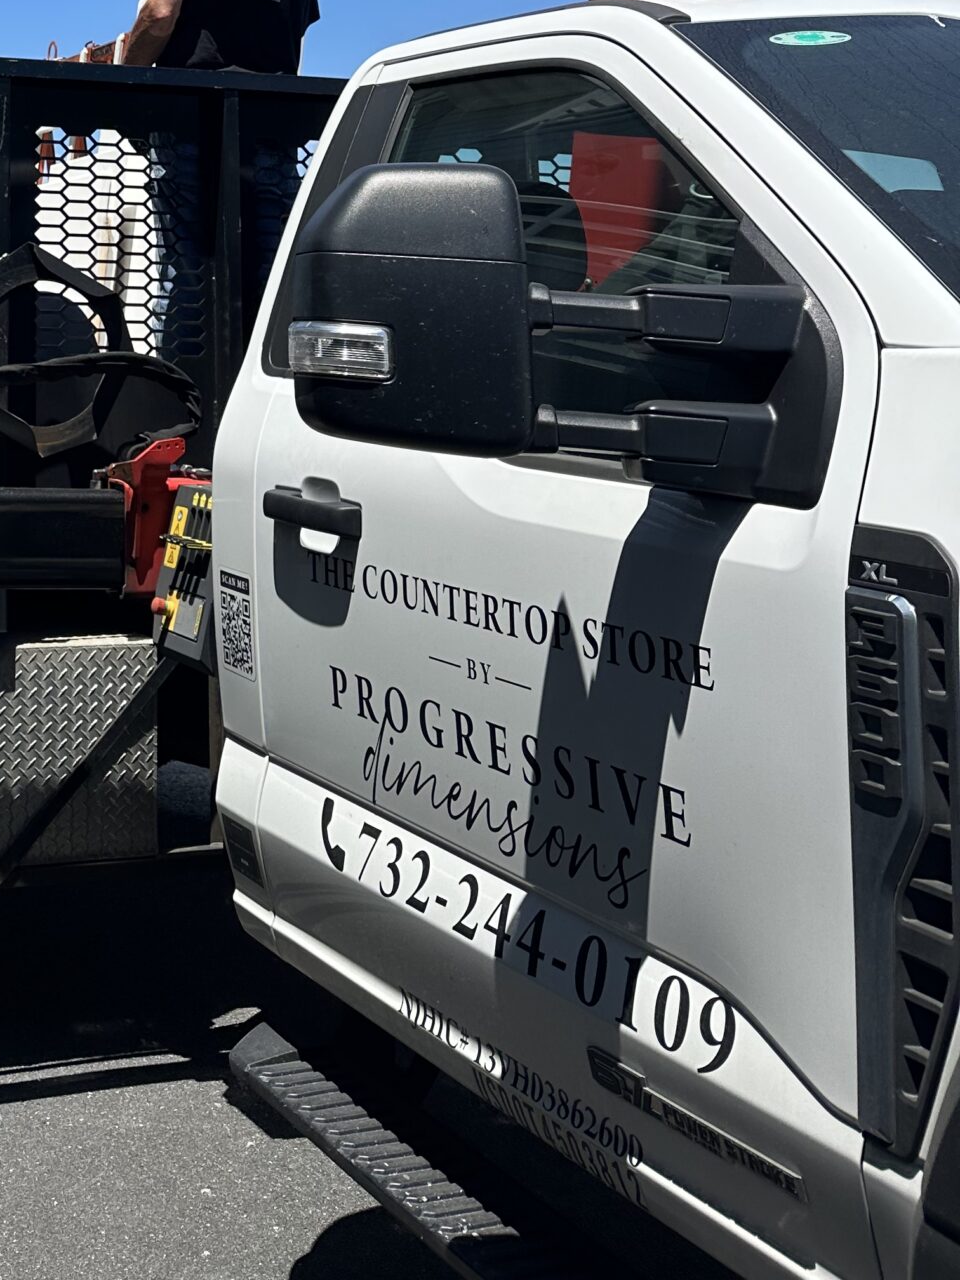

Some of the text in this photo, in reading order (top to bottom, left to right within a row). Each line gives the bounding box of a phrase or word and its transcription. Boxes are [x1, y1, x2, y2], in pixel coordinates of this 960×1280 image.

[221, 574, 248, 591] SCAN ME!
[307, 550, 716, 692] THE COUNTERTOP STORE
[861, 560, 898, 586] XL
[466, 657, 491, 685] BY
[329, 665, 692, 848] PROGRESSIVE
[363, 705, 648, 909] dimensions
[358, 822, 737, 1074] 732-244-0109
